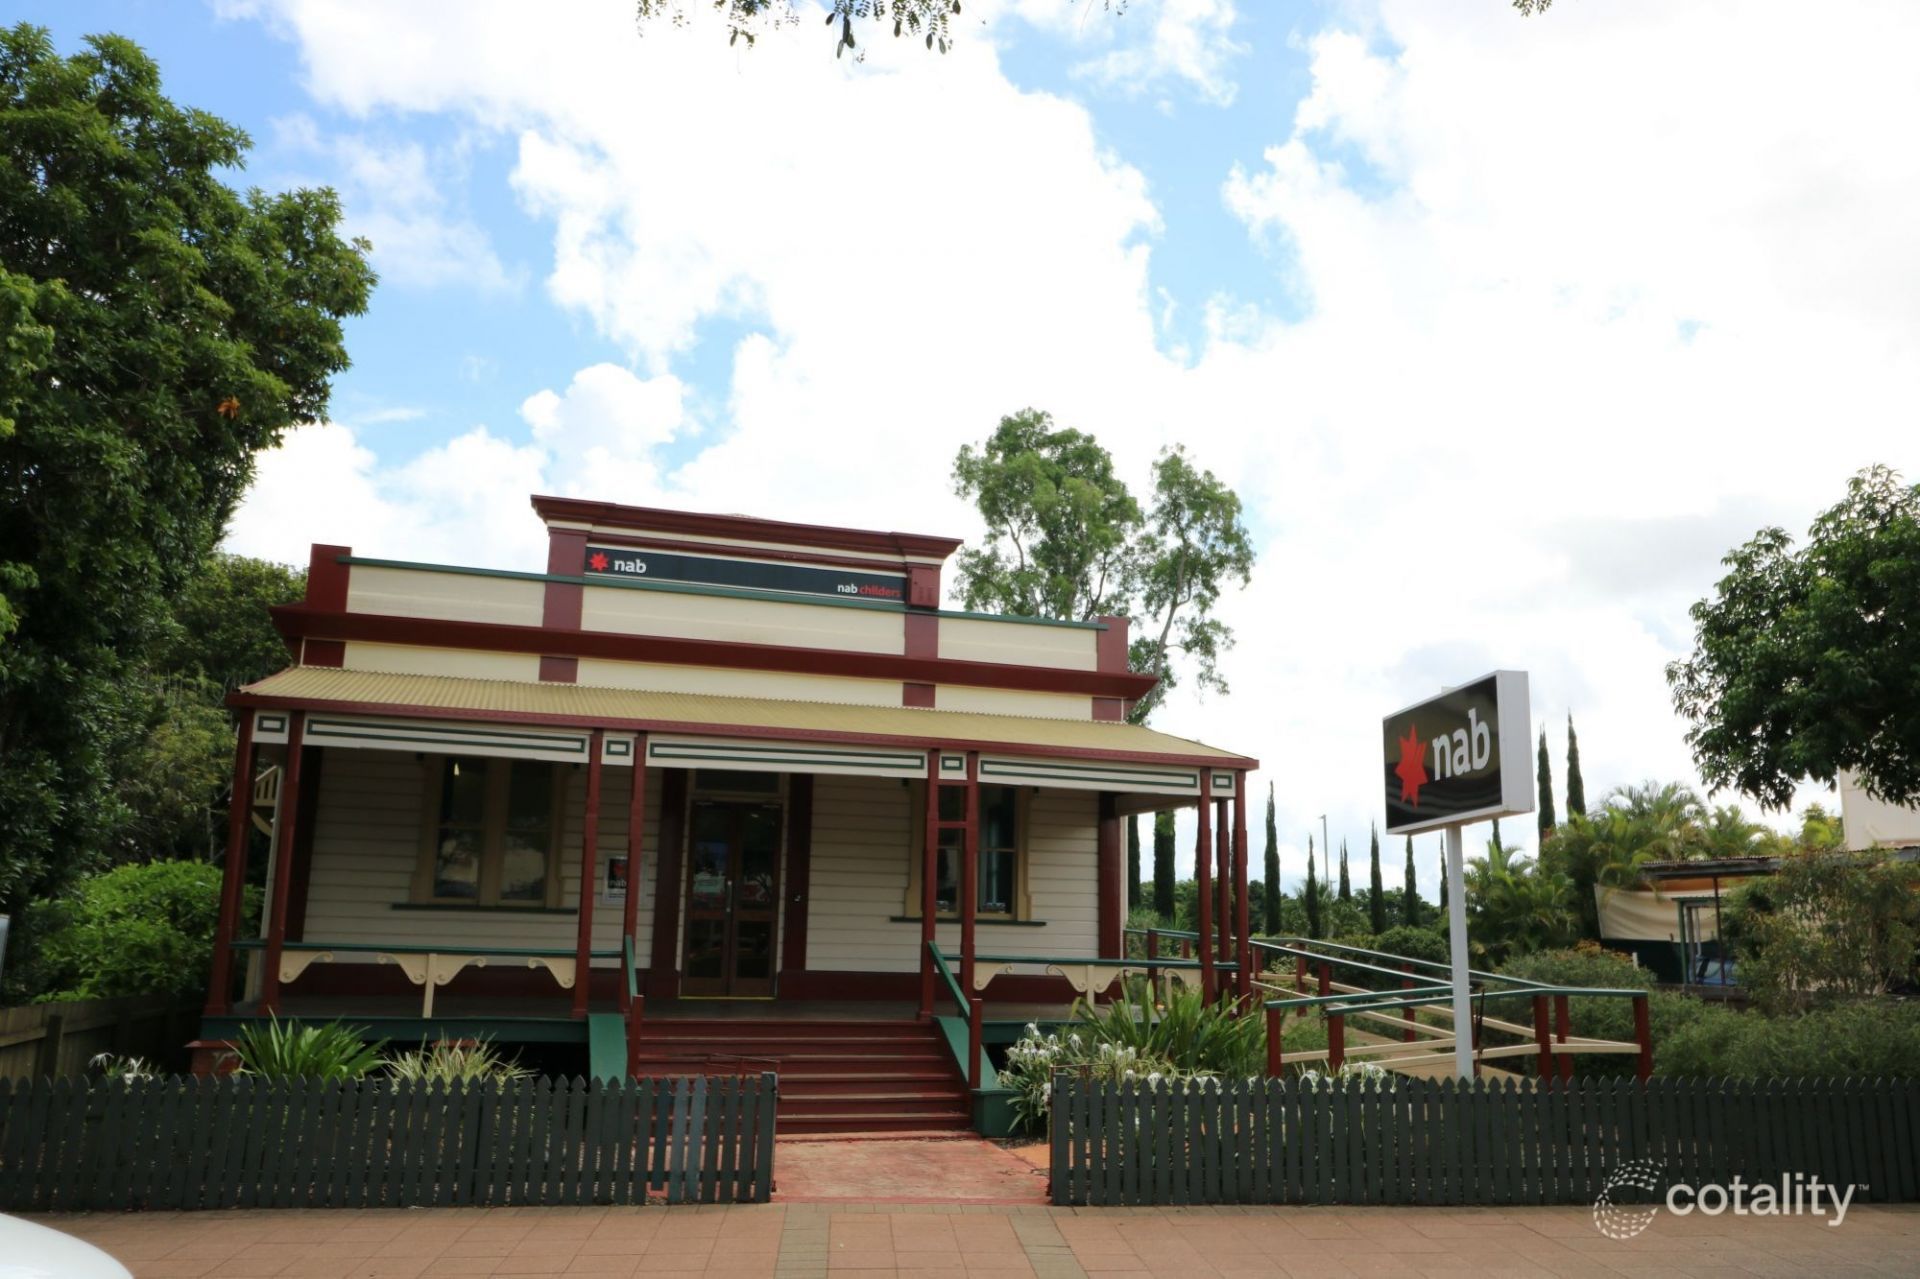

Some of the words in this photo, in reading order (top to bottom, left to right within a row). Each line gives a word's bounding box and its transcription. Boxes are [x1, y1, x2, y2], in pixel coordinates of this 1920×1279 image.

[614, 559, 647, 573] nab
[837, 583, 858, 594] nab
[1432, 708, 1491, 781] nab
